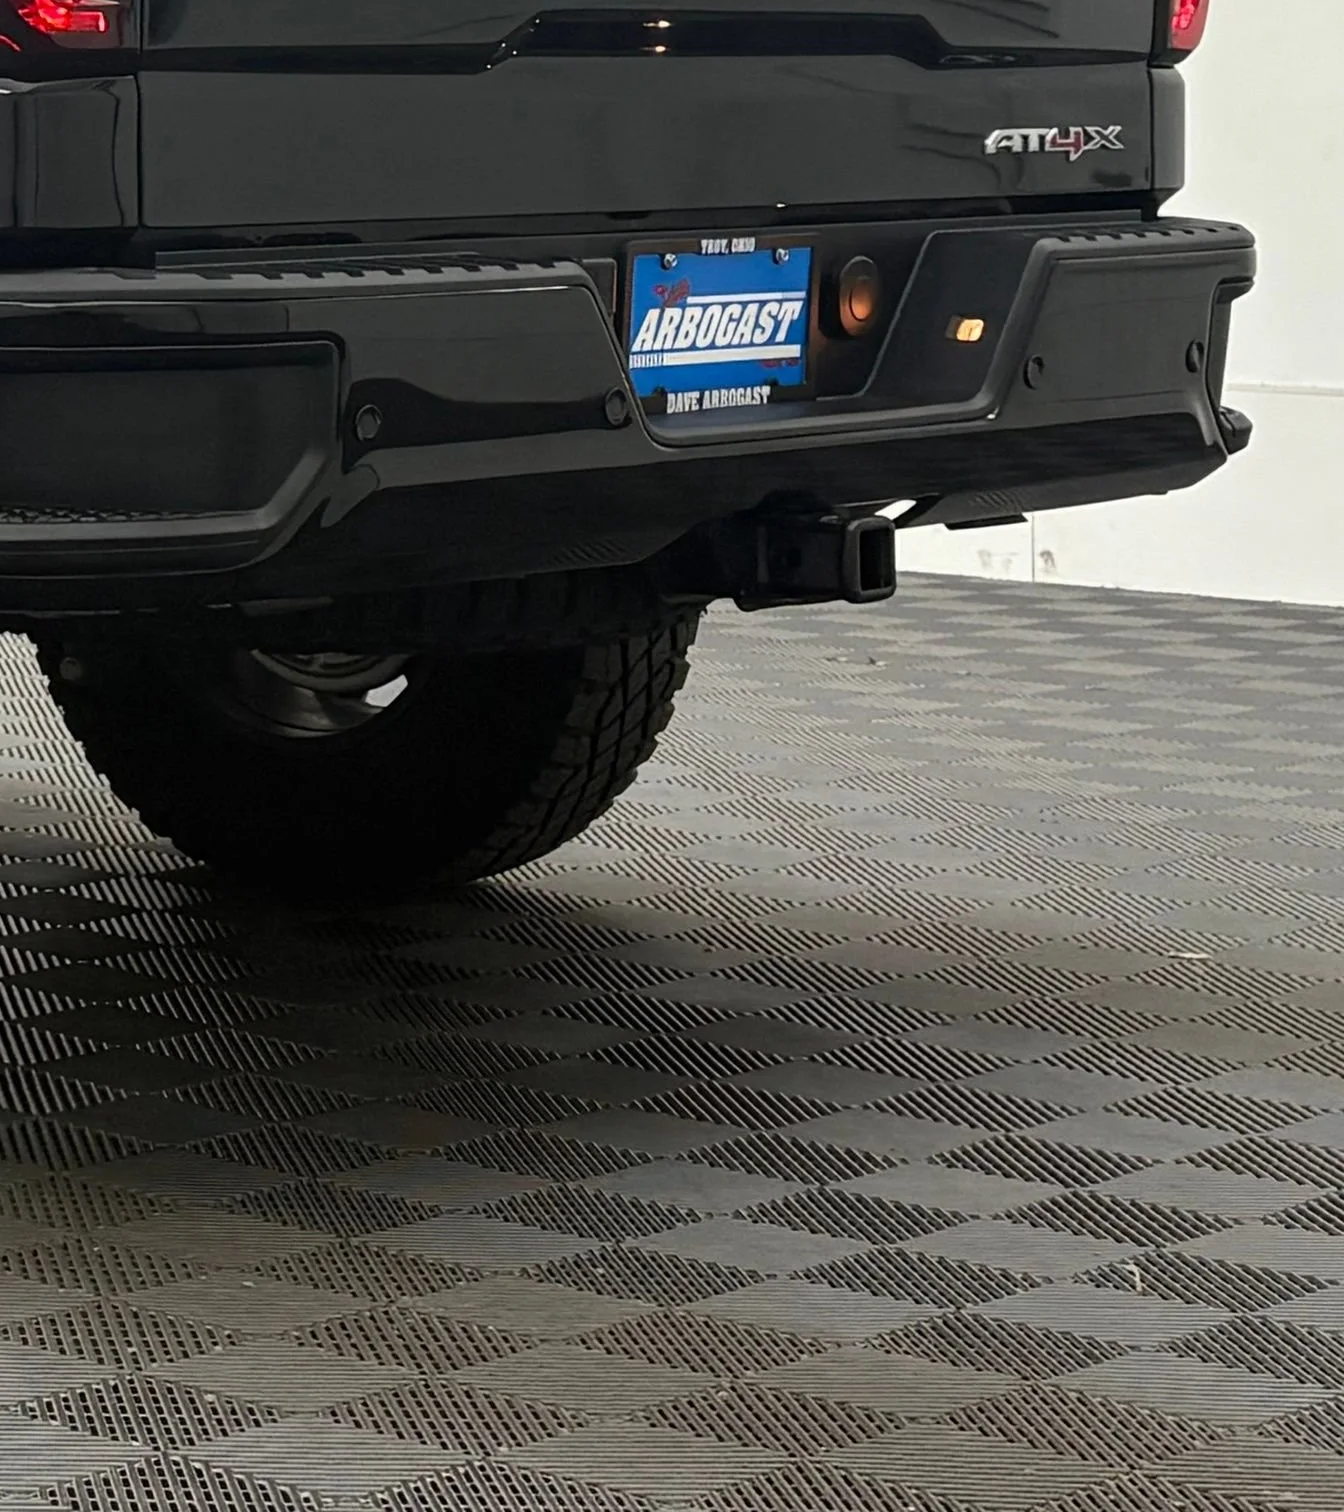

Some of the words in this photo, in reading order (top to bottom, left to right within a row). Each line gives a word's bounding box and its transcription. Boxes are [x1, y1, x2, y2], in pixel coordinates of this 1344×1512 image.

[983, 124, 1124, 162] AT4X
[630, 300, 805, 353] ARBOGAST
[666, 391, 700, 414] DAVE
[702, 386, 771, 410] ARBOGAST
